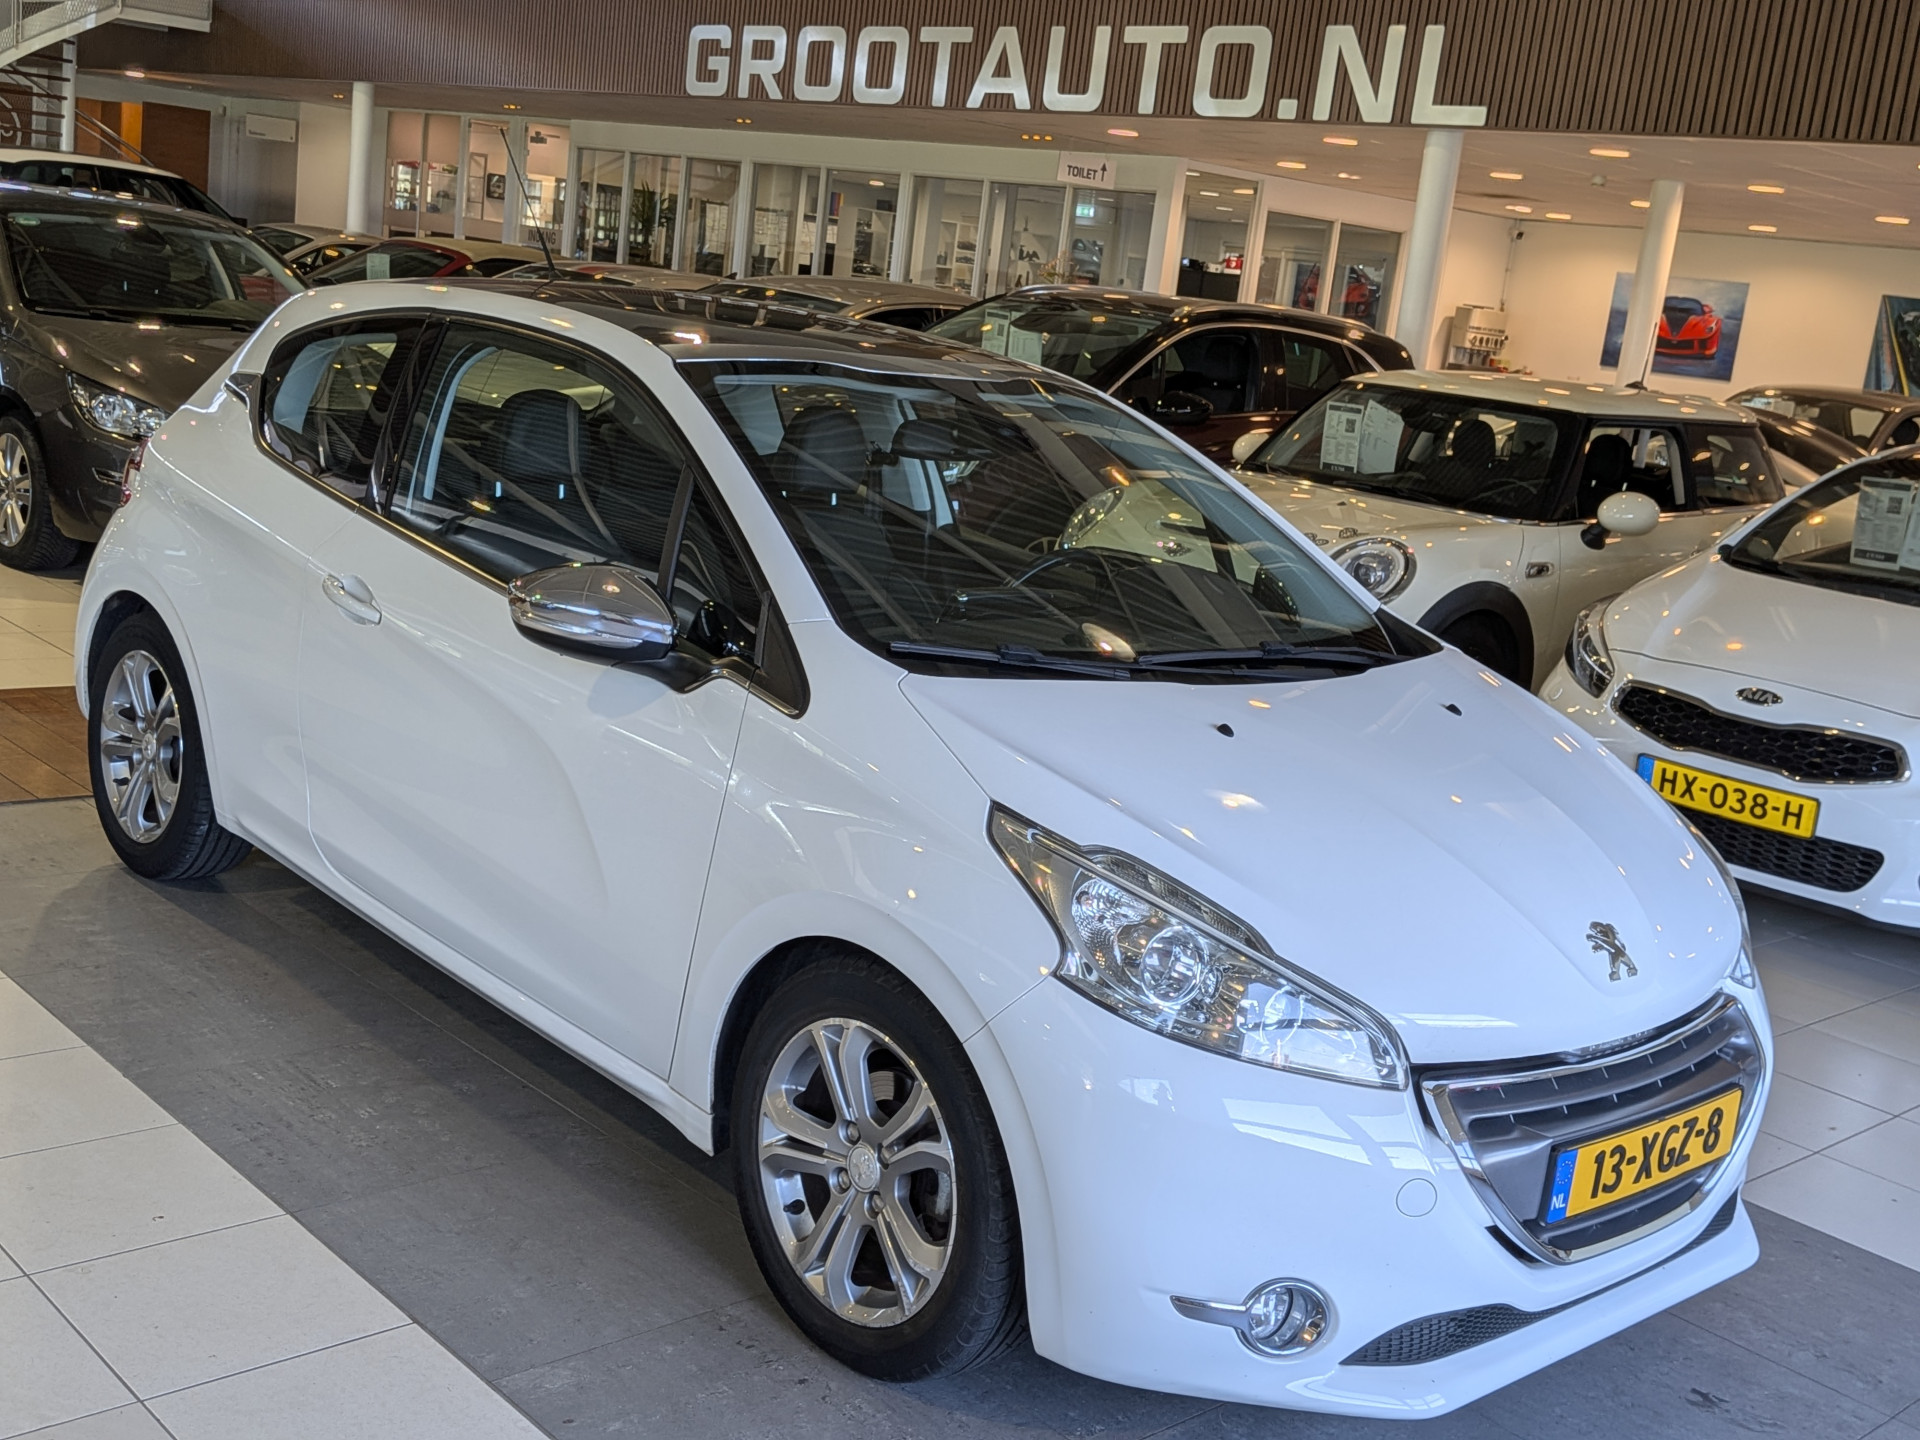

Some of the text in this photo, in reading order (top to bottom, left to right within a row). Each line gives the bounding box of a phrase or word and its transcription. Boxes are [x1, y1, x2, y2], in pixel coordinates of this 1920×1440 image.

[685, 24, 1488, 127] GROOTAUTO.NL
[1067, 164, 1098, 180] TOILET
[528, 229, 556, 245] INNG
[1740, 688, 1774, 705] KIA
[1659, 767, 1804, 830] HX-038-H
[1590, 1107, 1724, 1199] 13-XGZ-8
[1551, 1193, 1566, 1210] NL
